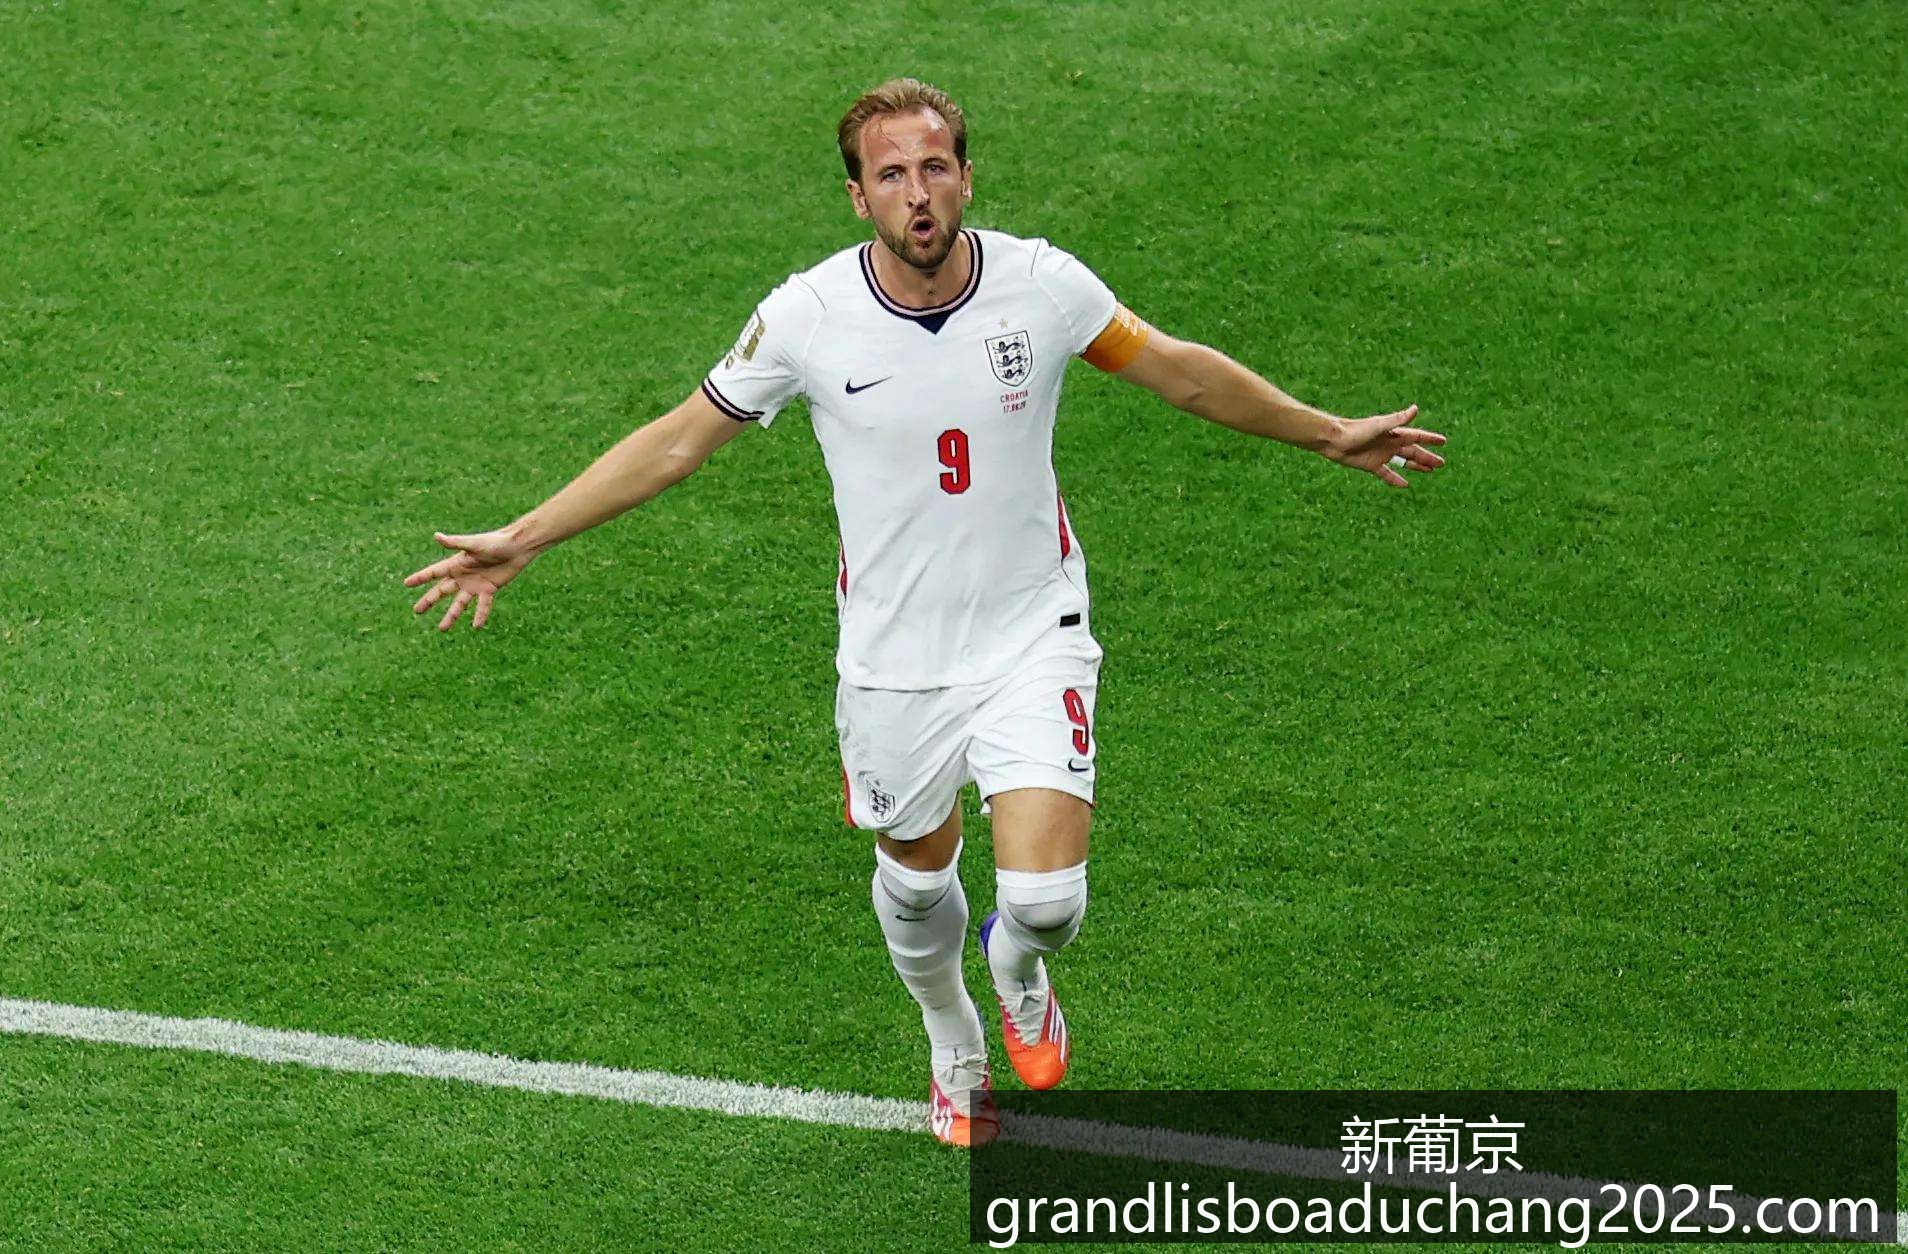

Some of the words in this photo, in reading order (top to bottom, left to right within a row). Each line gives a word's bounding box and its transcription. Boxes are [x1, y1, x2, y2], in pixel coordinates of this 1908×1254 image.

[1000, 389, 1028, 403] CROATIA
[937, 429, 970, 494] 9
[1063, 688, 1089, 756] 9
